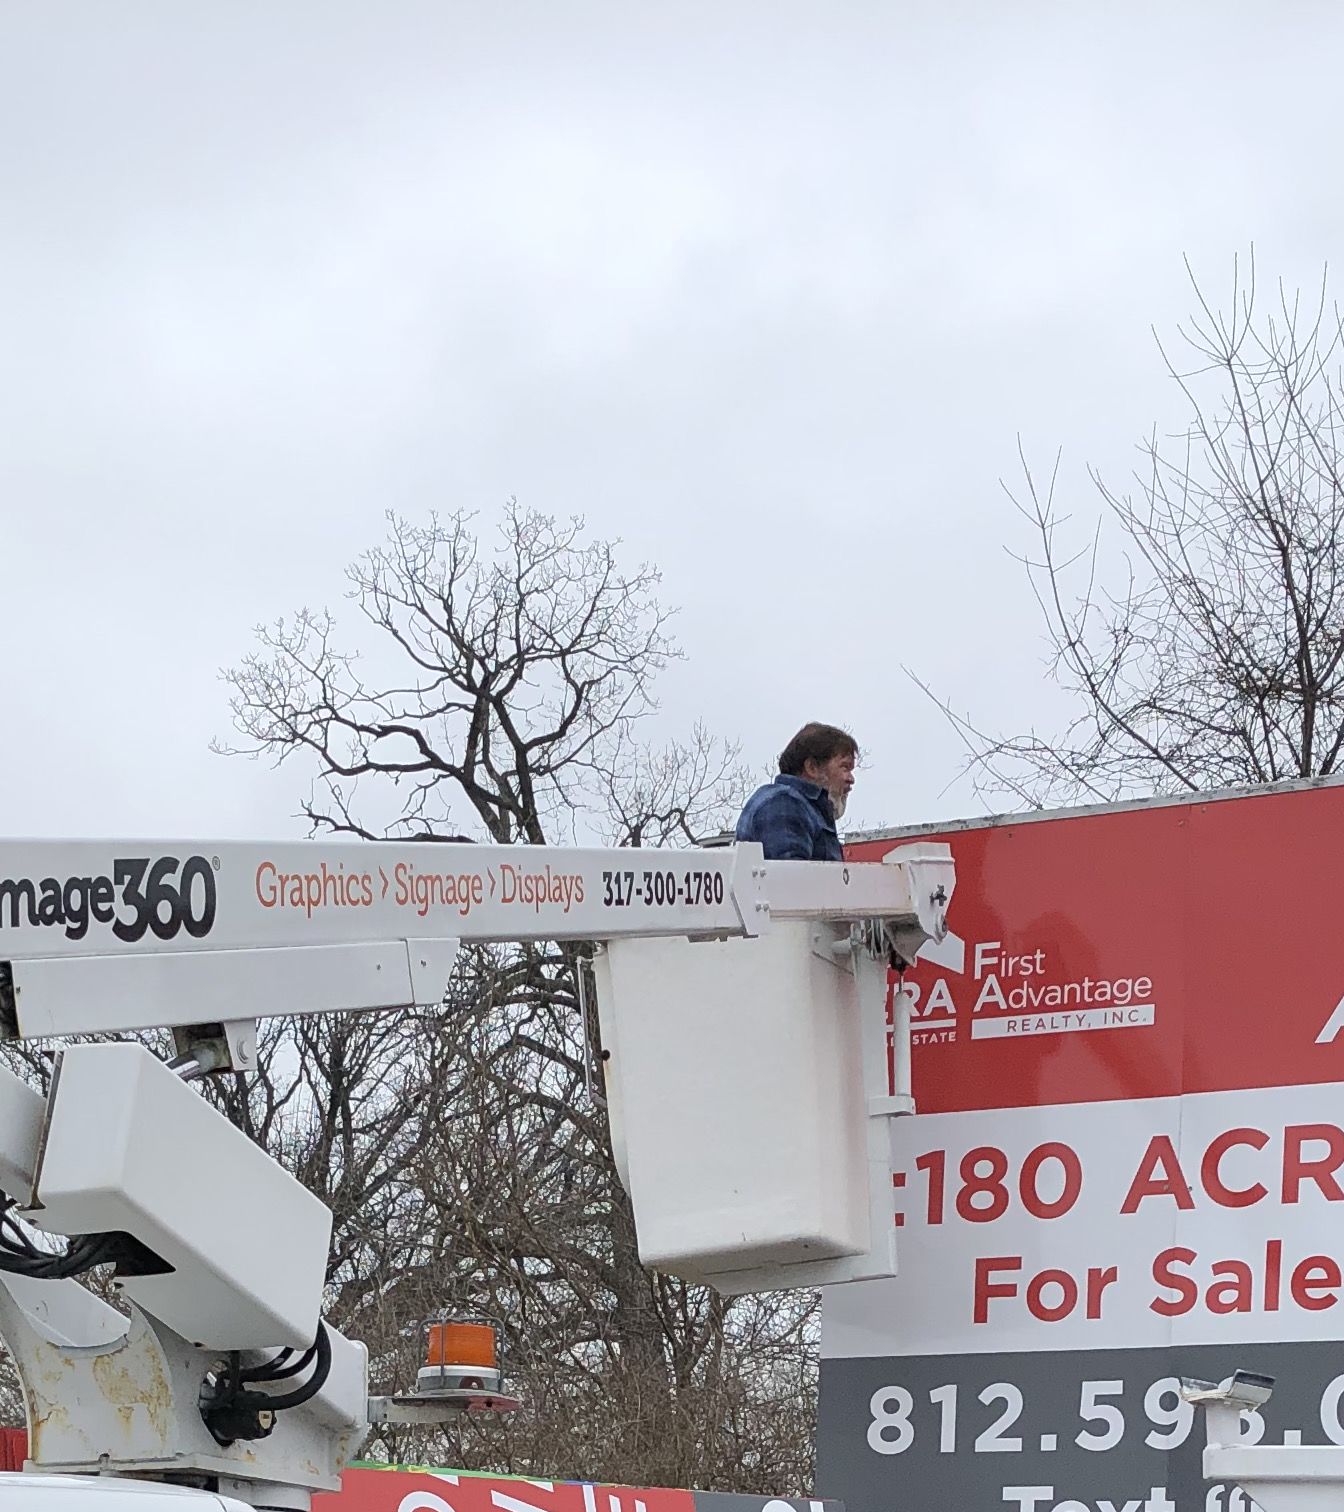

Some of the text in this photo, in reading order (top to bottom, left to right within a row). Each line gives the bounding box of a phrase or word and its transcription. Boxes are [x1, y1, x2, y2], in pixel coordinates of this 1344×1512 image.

[256, 861, 584, 918] Graphics Signage Displays
[601, 871, 724, 907] 317-300-1780
[974, 941, 1046, 979] First
[886, 978, 956, 1019] RA
[973, 973, 1152, 1012] Advantage
[1007, 1009, 1147, 1033] REALTY, INC.
[973, 1256, 1117, 1324] For
[1149, 1239, 1342, 1316] Sale
